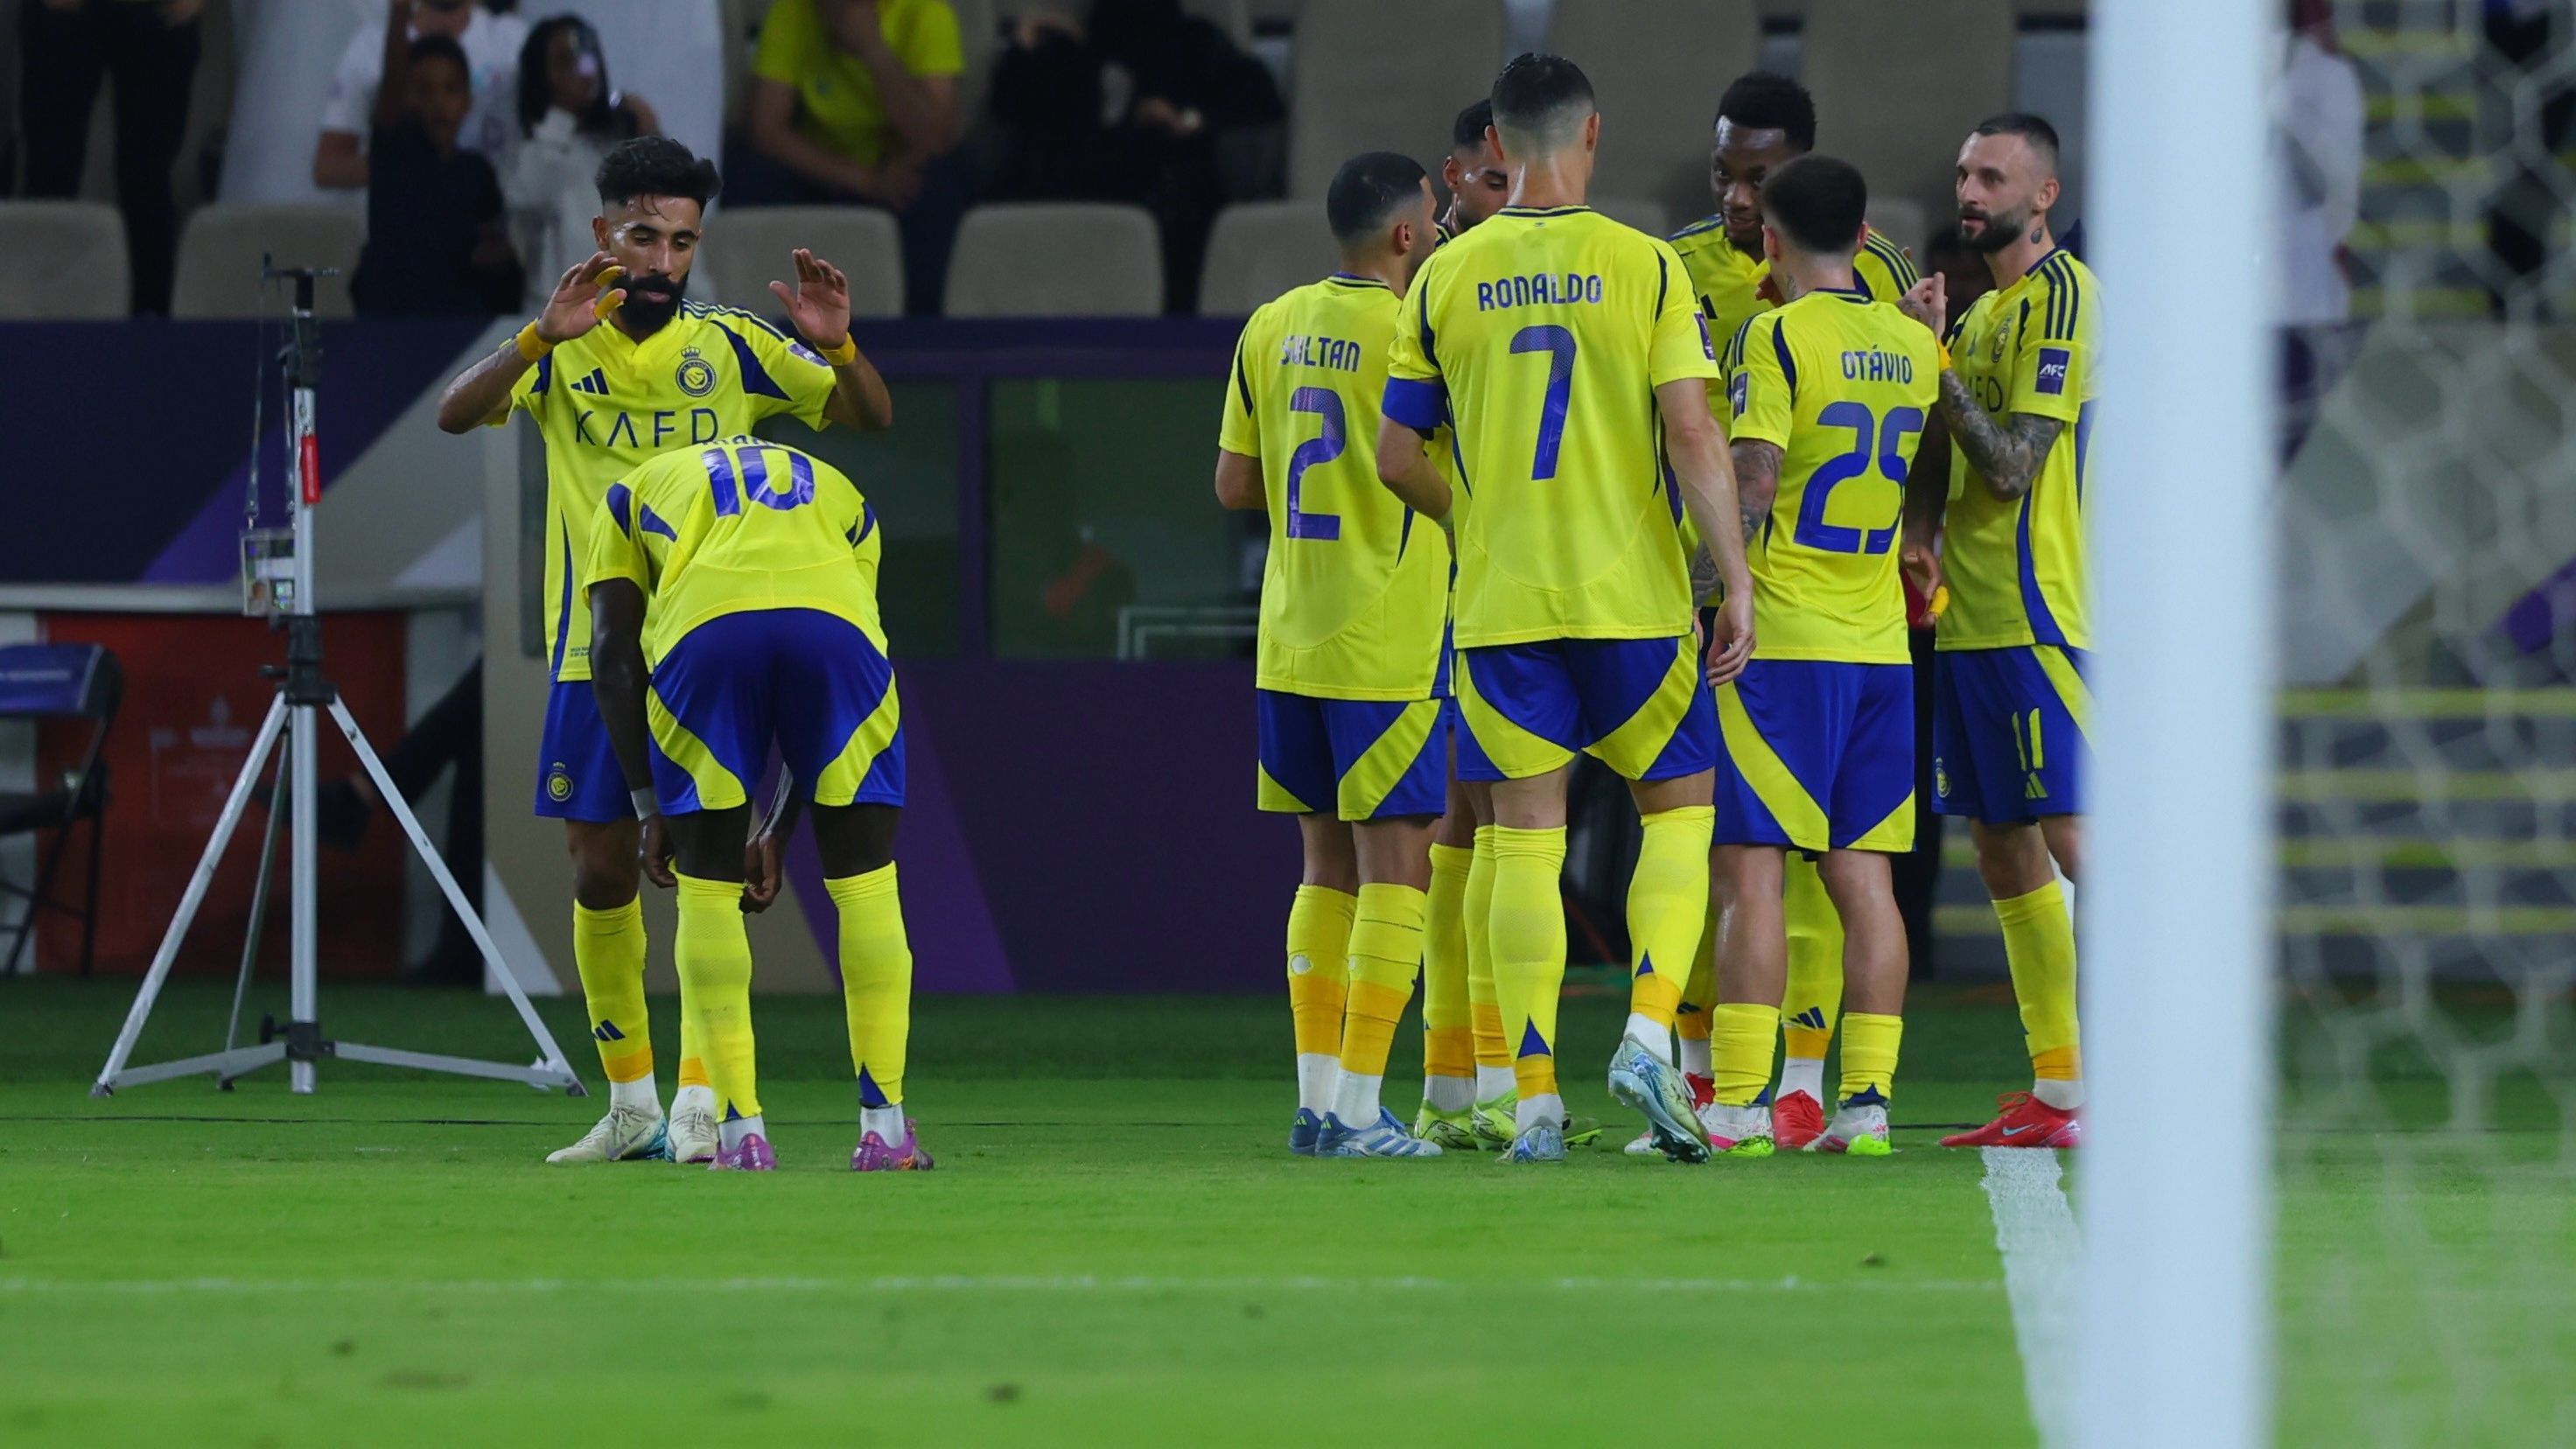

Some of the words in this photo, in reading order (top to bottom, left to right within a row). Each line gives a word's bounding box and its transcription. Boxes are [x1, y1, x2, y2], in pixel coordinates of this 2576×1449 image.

[1477, 272, 1602, 312] RONALDO
[1280, 334, 1362, 373] SULTAN
[1840, 343, 1912, 385] OTÁVIO
[2039, 363, 2066, 378] AFC
[573, 407, 719, 448] KAFD
[1509, 324, 1577, 480] 7
[700, 444, 815, 518] 10
[1286, 386, 1347, 542] 2
[1793, 401, 1924, 555] 25
[2012, 707, 2044, 772] 11
